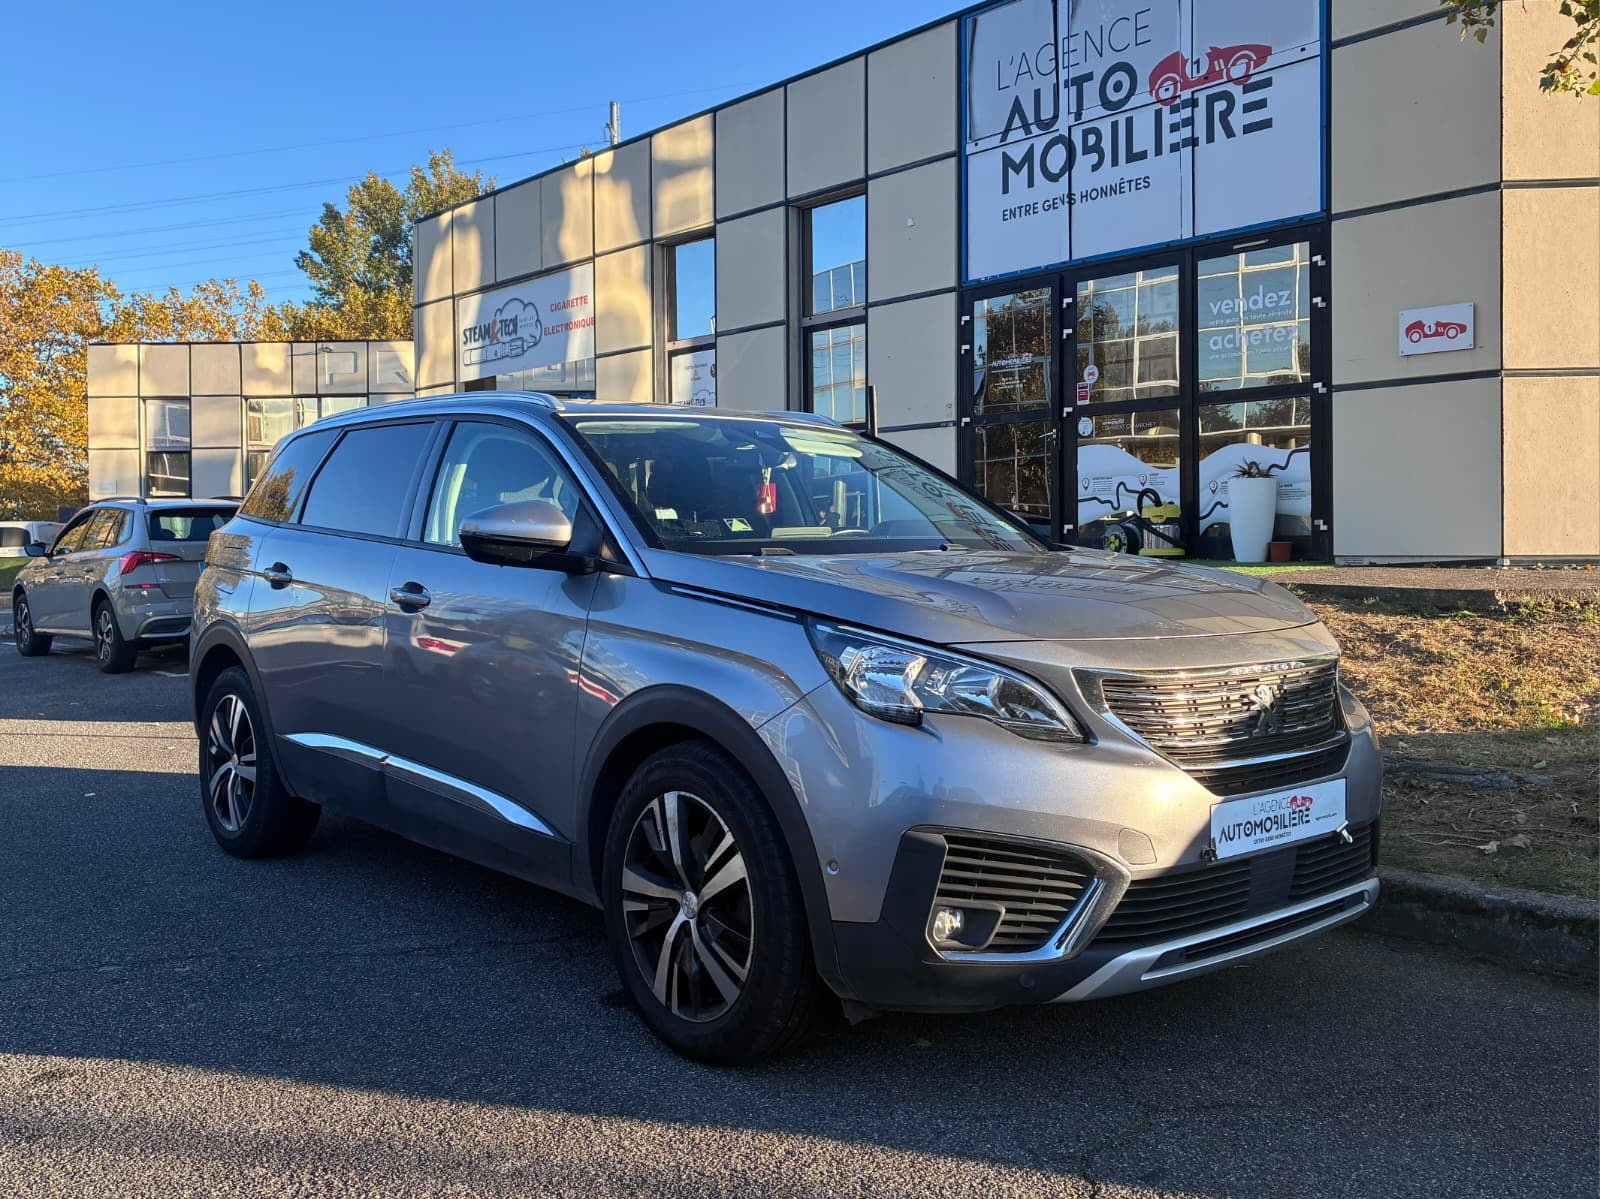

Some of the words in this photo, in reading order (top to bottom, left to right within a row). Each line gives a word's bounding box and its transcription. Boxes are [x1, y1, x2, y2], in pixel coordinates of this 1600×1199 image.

[997, 8, 1152, 91] L'AGENCE
[999, 61, 1138, 143] AUTO
[1002, 202, 1039, 222] ENTRE
[1042, 192, 1076, 212] GENS
[1080, 176, 1151, 203] HONNÊTES
[550, 295, 588, 313] CIGARETTE
[1209, 284, 1291, 315] vendez
[543, 316, 595, 336] ELECTRONIQUE
[1209, 323, 1297, 350] achetez
[1253, 796, 1290, 815] L'AGENCE
